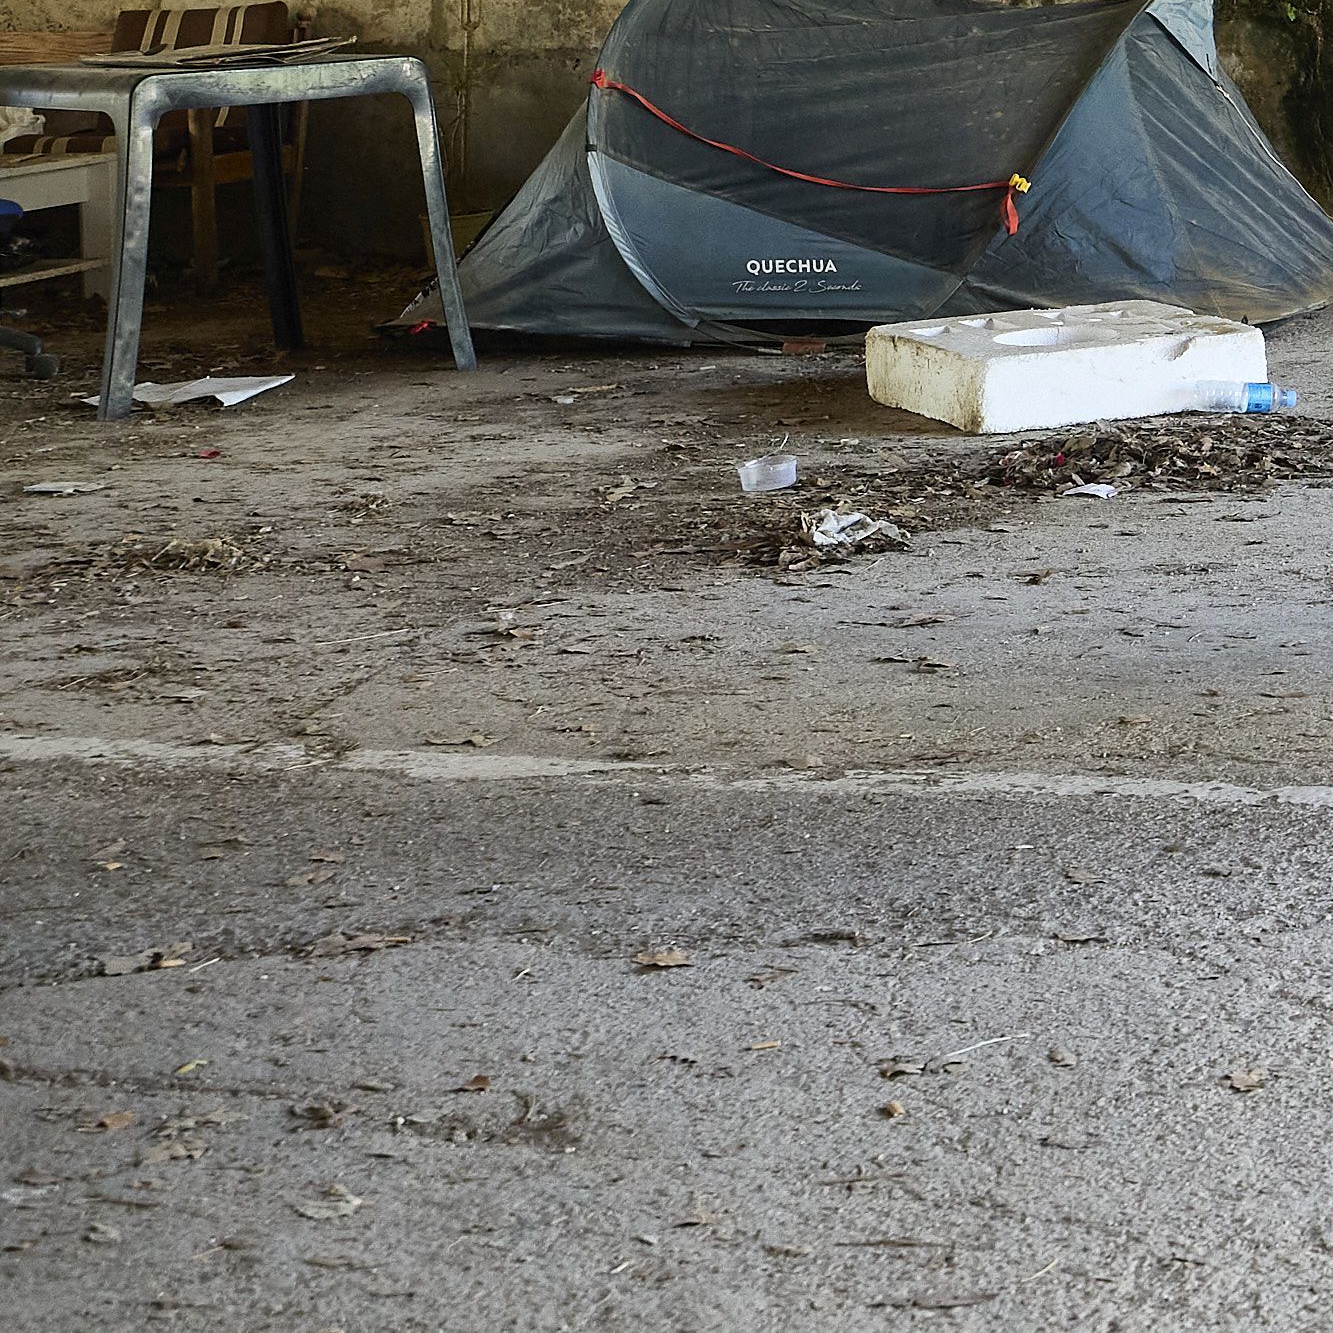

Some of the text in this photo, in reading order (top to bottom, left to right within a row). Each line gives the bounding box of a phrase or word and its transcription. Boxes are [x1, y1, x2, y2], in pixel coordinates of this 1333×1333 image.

[746, 259, 837, 275] QUECHUA
[732, 280, 756, 293] The
[794, 279, 807, 292] 2
